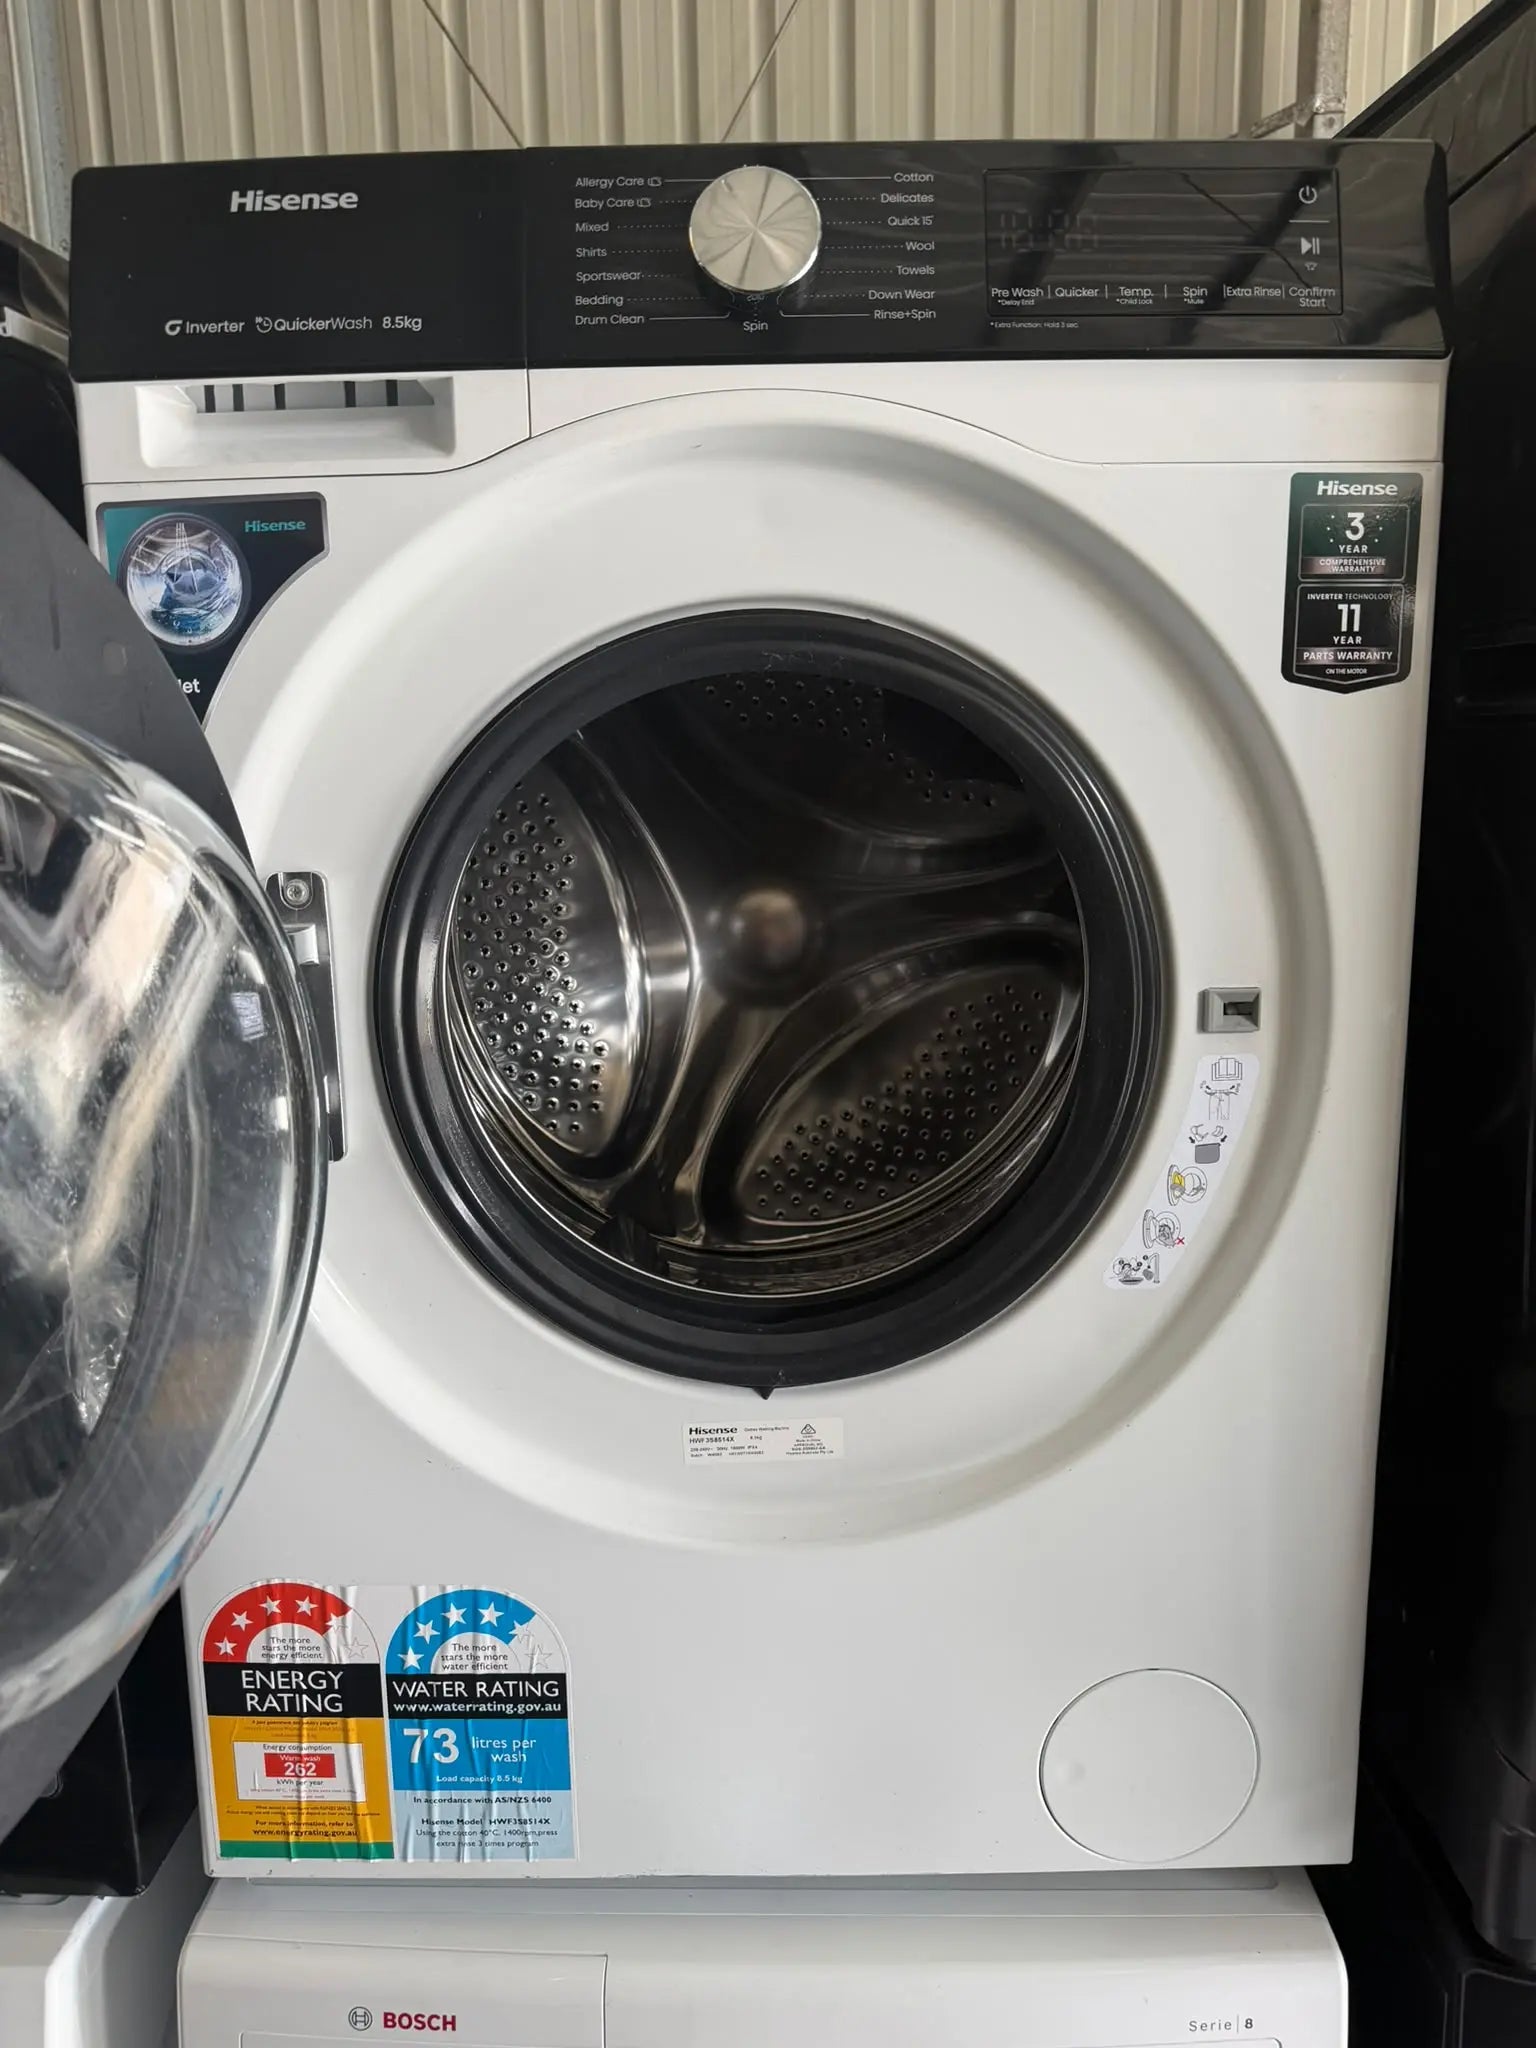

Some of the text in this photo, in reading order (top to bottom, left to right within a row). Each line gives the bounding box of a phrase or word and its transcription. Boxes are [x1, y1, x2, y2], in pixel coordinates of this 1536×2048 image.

[575, 176, 644, 189] Allergy Care
[893, 172, 934, 183] Cotton
[230, 190, 359, 212] Hisense
[575, 197, 635, 210] Baby Care
[880, 193, 934, 203] Delicates
[887, 215, 920, 226] Quick
[575, 221, 609, 233] Mixed
[575, 246, 607, 258] Shirts
[905, 241, 935, 251] Wool
[575, 270, 641, 283] Sportswear
[896, 265, 935, 276] Towels
[868, 289, 935, 300] Down Wear
[991, 287, 1044, 298] Pre Wash
[1054, 286, 1099, 298] Quicker
[1118, 286, 1154, 300] Temp.
[1183, 286, 1208, 300] Spin
[1226, 286, 1282, 297] Extra Rinse
[1288, 286, 1336, 297] Confirm
[575, 294, 624, 307] Bedding
[1299, 297, 1326, 308] Start
[575, 313, 645, 325] Drum Clean
[873, 308, 936, 321] Rinse+Spin
[186, 315, 423, 334] Inverter QuickerWash 8.5kg
[743, 320, 769, 332] Spin
[1317, 480, 1398, 496] Hisense
[245, 520, 306, 533] Hisense
[1345, 512, 1365, 541] 3
[1339, 545, 1368, 554] YEAR
[1337, 604, 1361, 632] 11
[1333, 636, 1362, 645] YEAR
[1303, 652, 1393, 661] PARTS WARRANTY
[177, 678, 201, 694] et
[689, 1427, 738, 1435] Hisense
[270, 1636, 287, 1644] The
[451, 1643, 497, 1652] The more
[261, 1652, 288, 1661] energy
[441, 1654, 464, 1662] stars
[466, 1653, 481, 1661] the
[471, 1663, 509, 1671] efficient
[241, 1670, 344, 1690] ENERGY
[393, 1681, 559, 1697] WATER RATING
[246, 1693, 343, 1713] RATING
[393, 1701, 561, 1715] www.waterrating.gov.au
[263, 1744, 286, 1752] Energy
[403, 1727, 460, 1764] 73
[471, 1736, 536, 1752] litres per
[491, 1751, 527, 1763] wash
[283, 1762, 317, 1776] 262
[460, 1776, 494, 1784] capacity
[512, 1776, 523, 1784] kg
[255, 1819, 267, 1827] For
[457, 1818, 483, 1826] Model
[253, 1828, 358, 1838] www.energyrating.gov.au
[416, 1829, 436, 1837] Using
[383, 2011, 457, 2032] BOSCH
[1188, 2018, 1254, 2032] Serie 8
